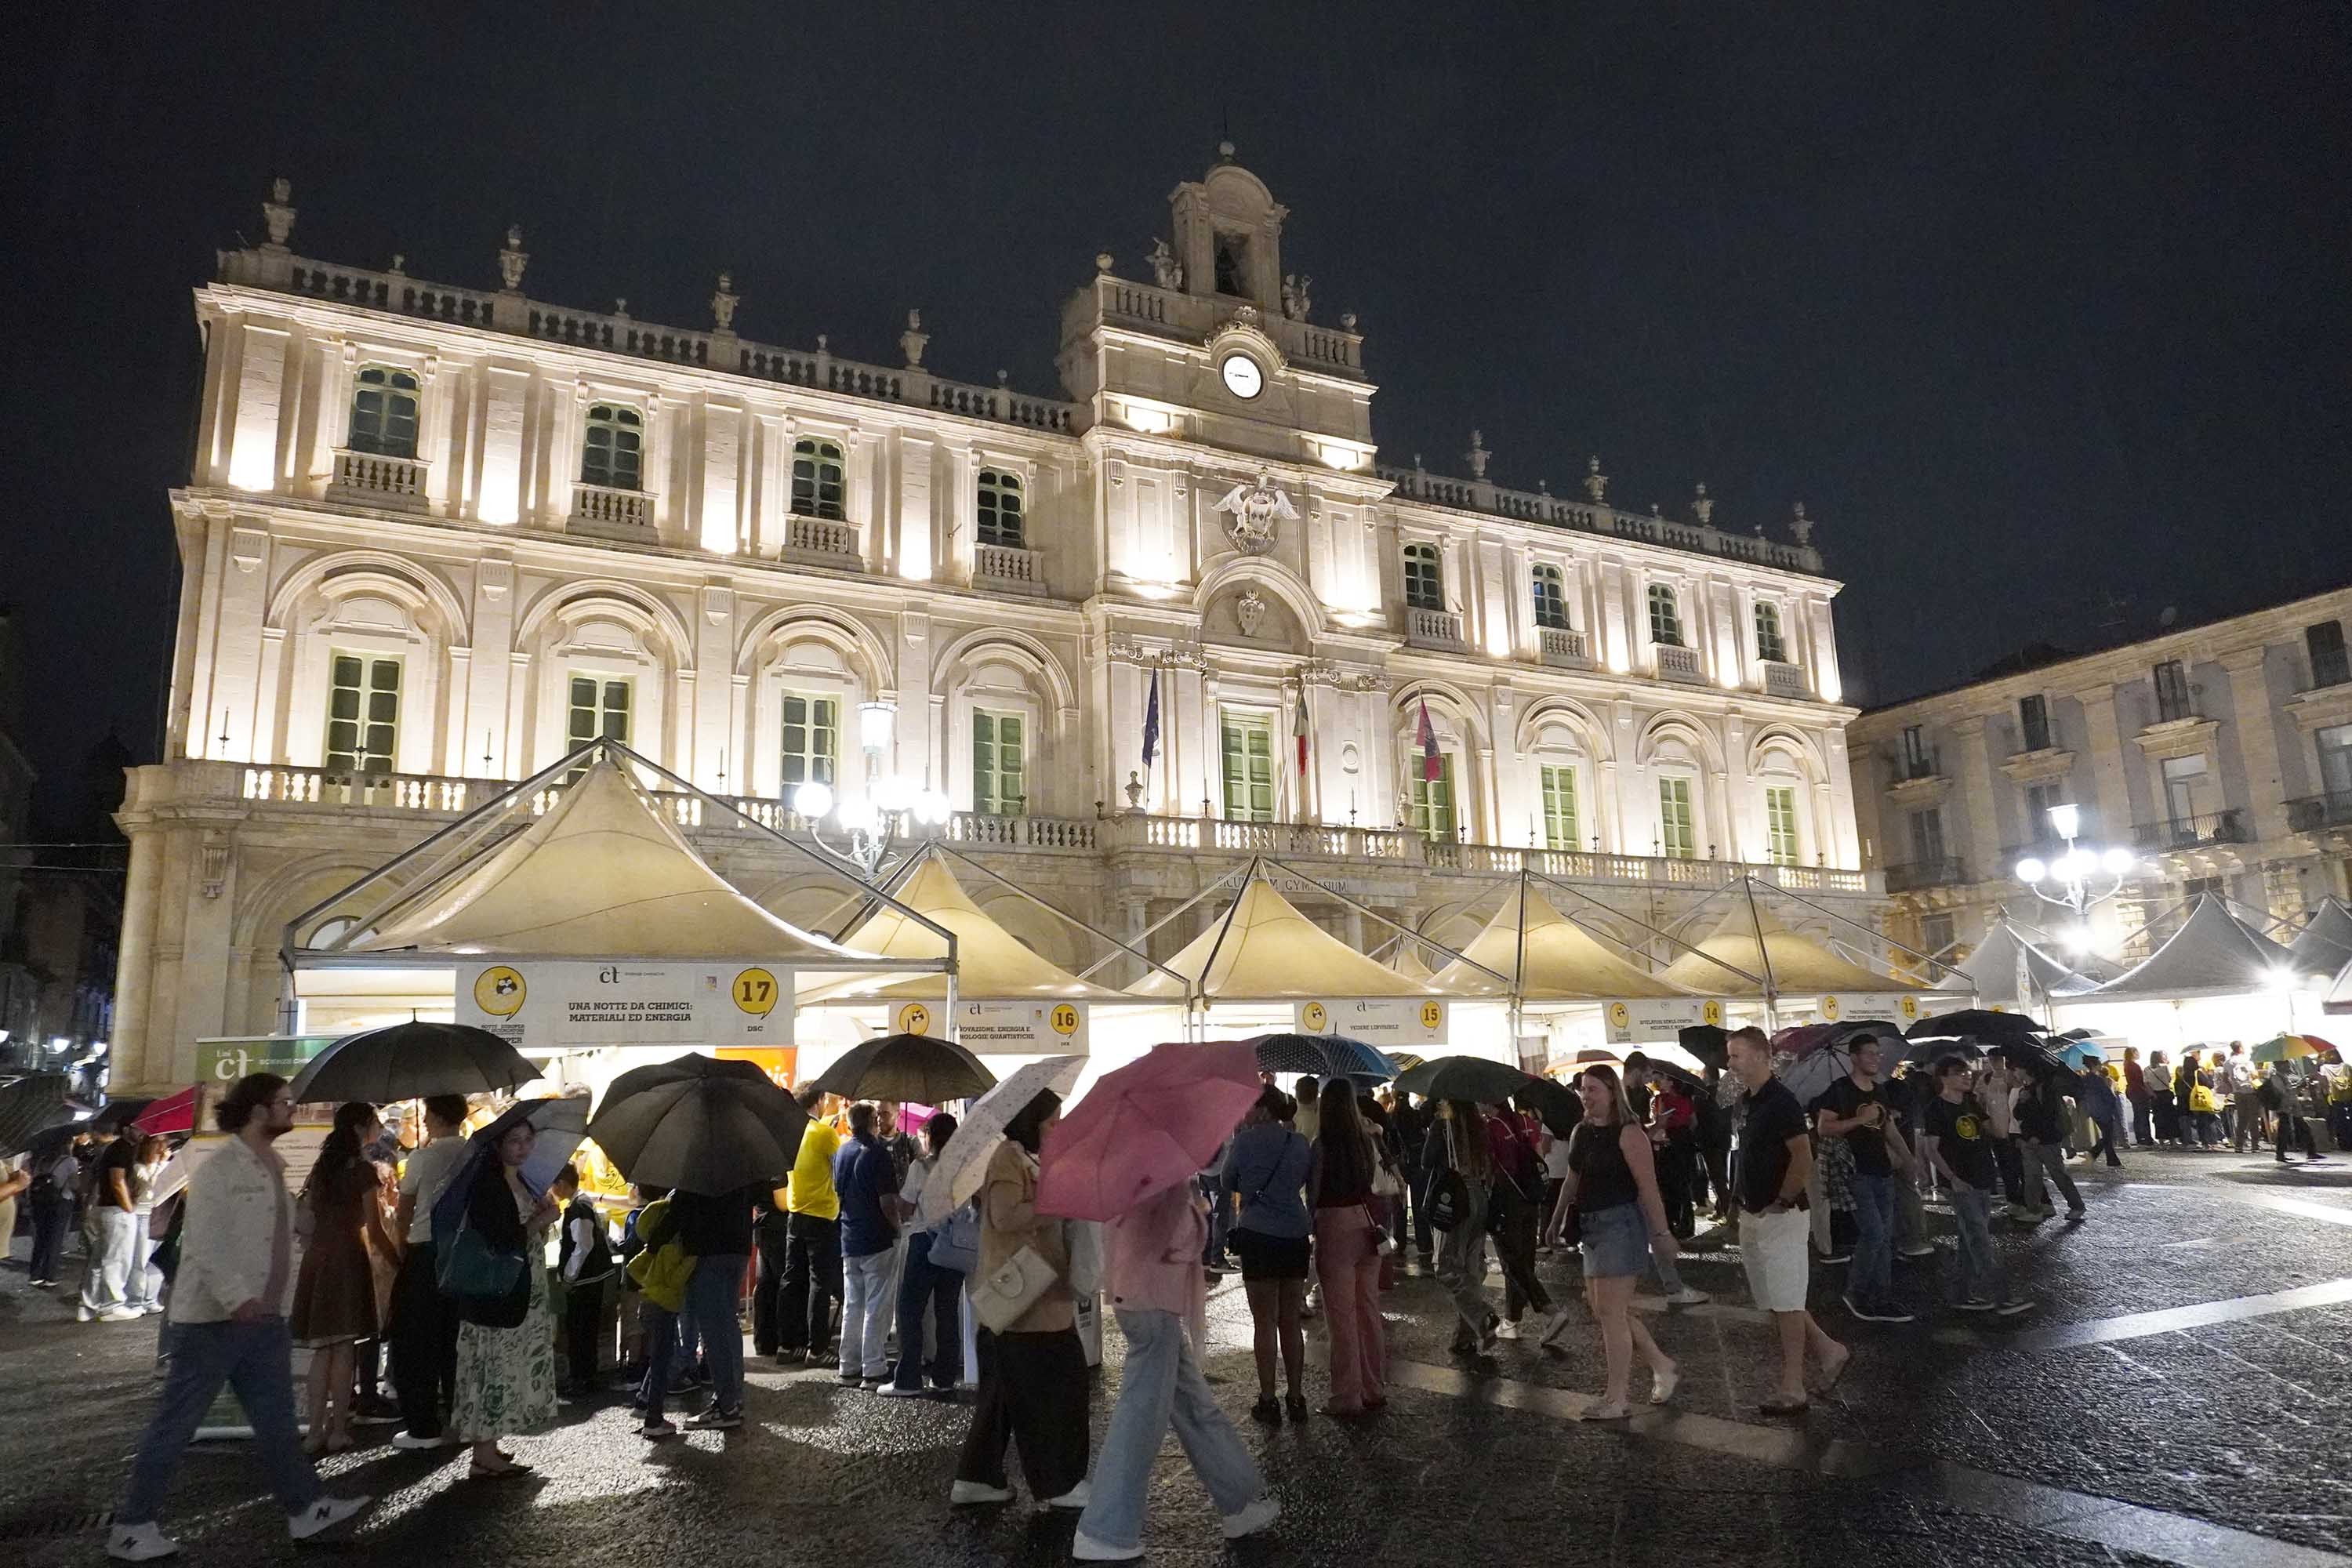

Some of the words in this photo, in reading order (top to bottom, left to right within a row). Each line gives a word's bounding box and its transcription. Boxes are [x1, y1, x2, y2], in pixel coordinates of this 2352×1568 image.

[742, 981, 771, 1002] 17
[568, 1002, 591, 1011] UNA
[593, 1002, 627, 1011] NOTTE
[630, 1002, 645, 1011] DA
[647, 1002, 693, 1011] CHIMICI:
[1706, 1007, 1718, 1018] 14
[1905, 1002, 1915, 1013] 13
[568, 1013, 626, 1022] MATERIALI
[628, 1013, 642, 1022] ED
[644, 1013, 691, 1022] ENERGIA
[1056, 1012, 1075, 1026] 16
[1424, 1008, 1438, 1021] 15
[215, 1049, 253, 1080] ct
